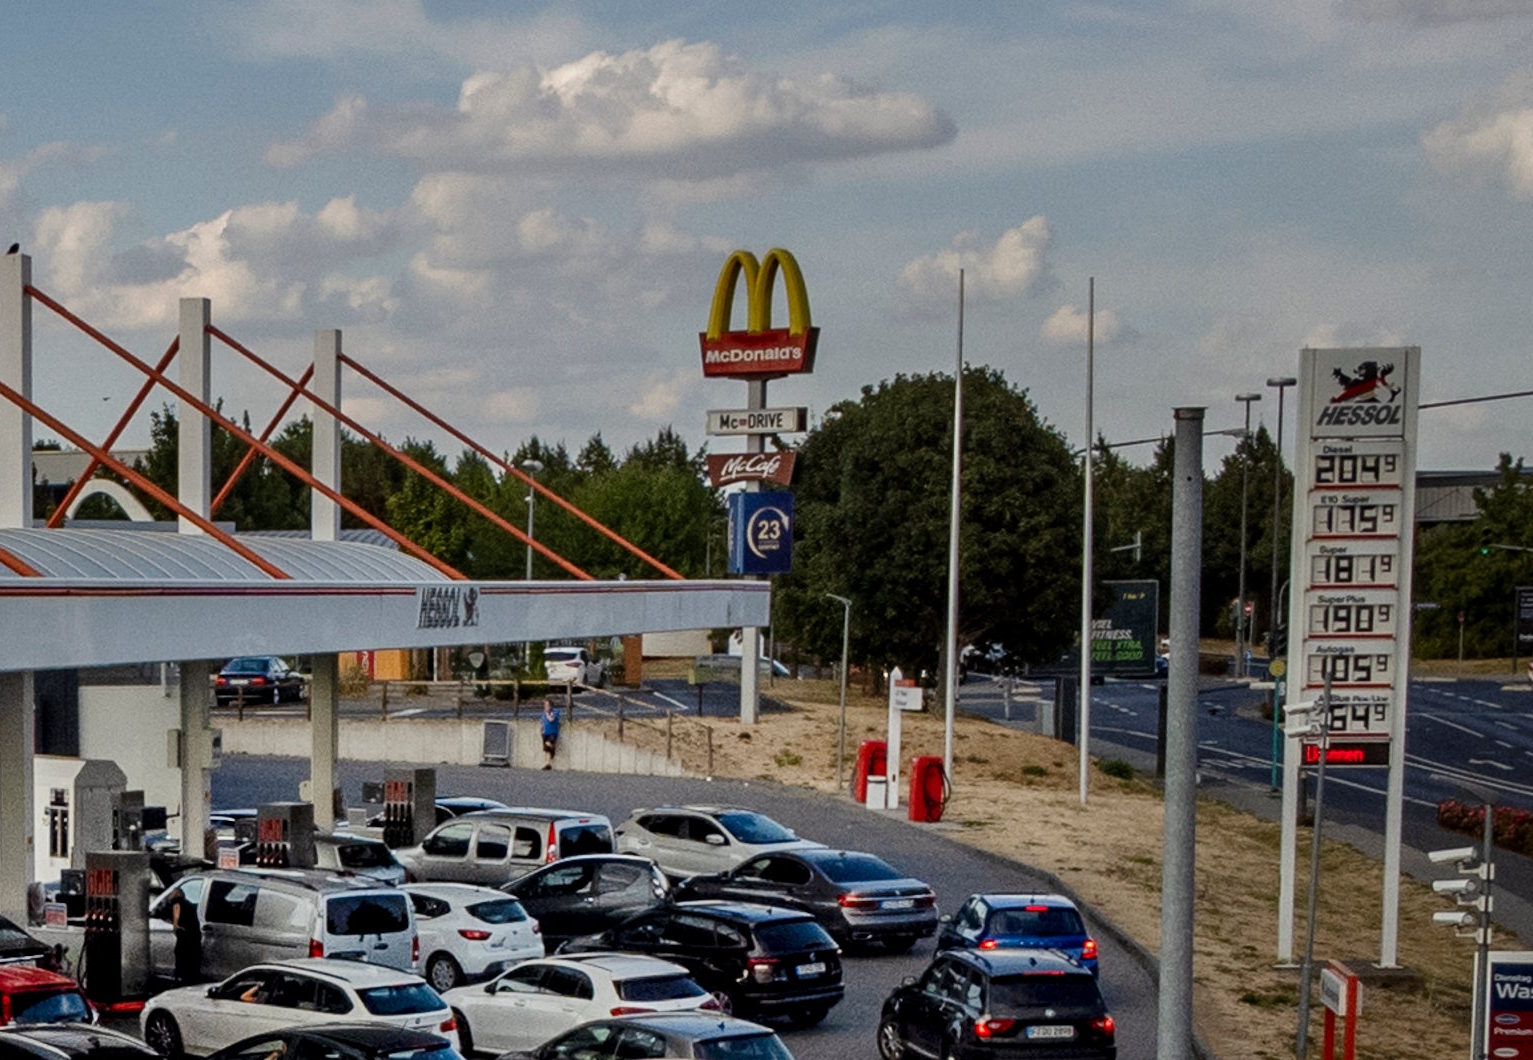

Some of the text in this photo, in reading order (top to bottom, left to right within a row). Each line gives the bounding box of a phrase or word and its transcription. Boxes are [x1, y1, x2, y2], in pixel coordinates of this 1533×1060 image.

[705, 347, 801, 363] McDonald's
[748, 412, 783, 428] DRIVE
[1316, 404, 1401, 426] HESSOL
[1323, 444, 1353, 454] Diesel
[1321, 494, 1370, 505] E10 Super
[758, 520, 780, 540] 23
[1319, 545, 1347, 555] Super
[417, 587, 461, 629] HESSOL
[1494, 973, 1532, 984] Dienstag
